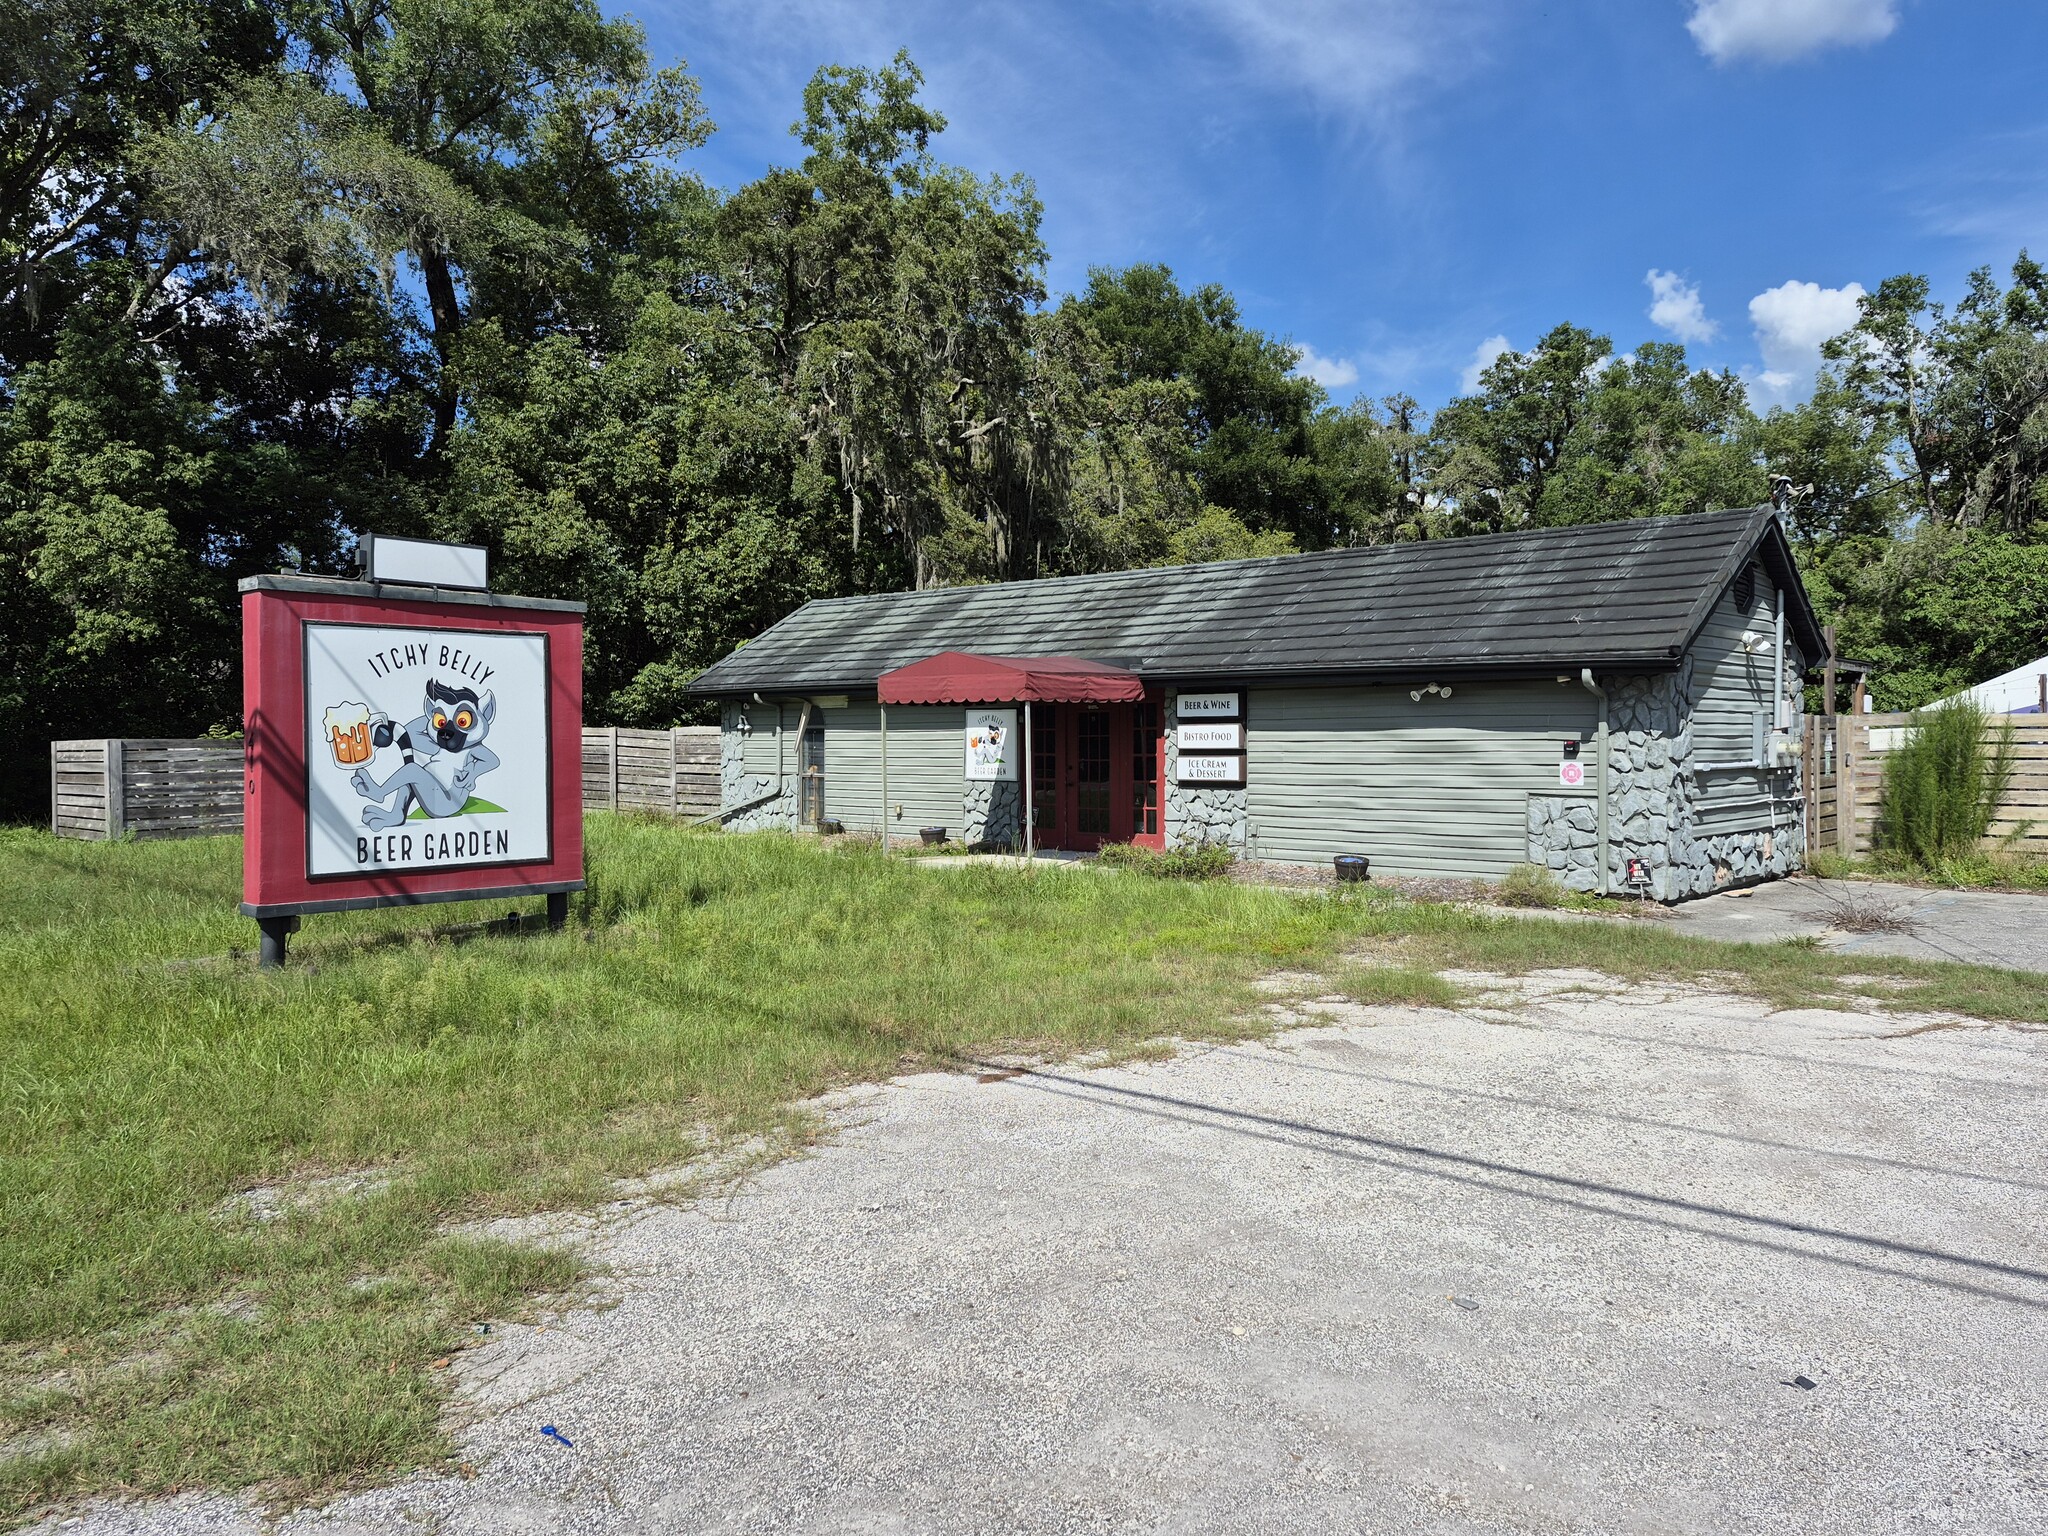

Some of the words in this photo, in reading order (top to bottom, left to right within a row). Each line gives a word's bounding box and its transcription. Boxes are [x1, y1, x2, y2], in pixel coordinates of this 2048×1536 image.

[367, 643, 429, 678] ITCHY
[438, 645, 495, 685] BELLY
[1184, 700, 1201, 710] BEER
[1202, 700, 1209, 710] &
[1210, 700, 1231, 709] WINE
[1184, 731, 1209, 741] BISTRO
[1211, 731, 1232, 741] FOOD
[1188, 759, 1200, 768] ICE
[1201, 759, 1227, 768] CREAM
[1188, 769, 1194, 778] &
[1196, 769, 1226, 778] DESSERT
[356, 834, 413, 864] BEER
[424, 829, 508, 860] GARDEN
